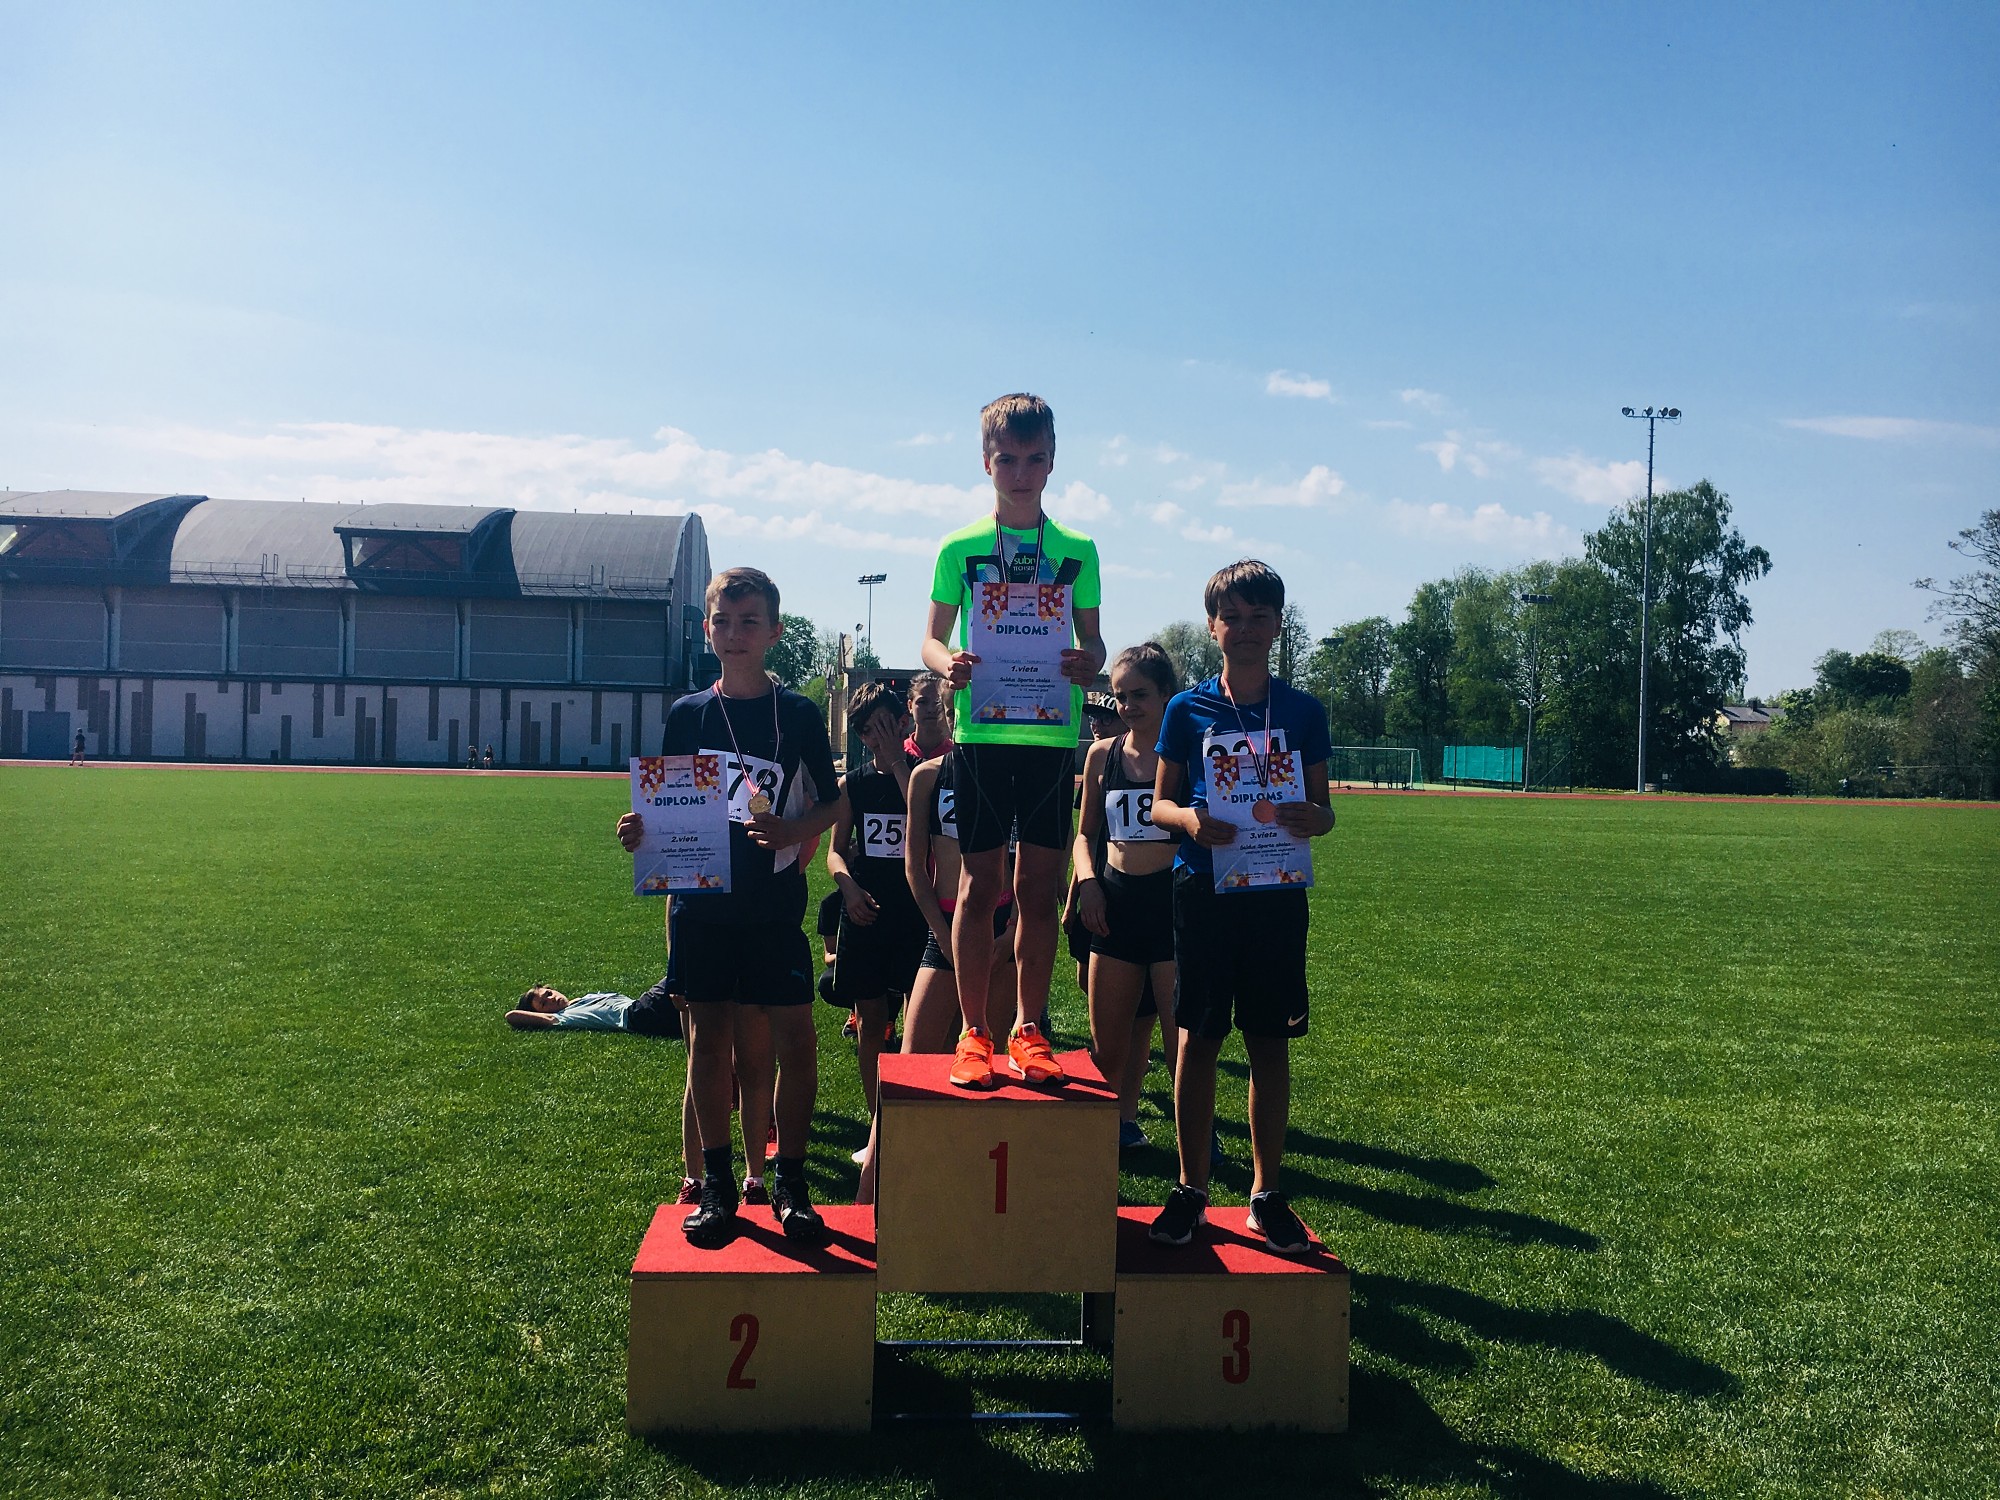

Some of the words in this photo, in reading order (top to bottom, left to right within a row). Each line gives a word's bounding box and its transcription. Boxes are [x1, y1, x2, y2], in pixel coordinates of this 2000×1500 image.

[996, 624, 1049, 635] DIPLOMS
[654, 796, 706, 807] DIPLOMS
[1230, 791, 1283, 803] DIPLOMS
[867, 819, 907, 845] 25
[988, 1141, 1009, 1215] 1
[726, 1313, 761, 1389] 2
[1221, 1309, 1251, 1385] 3
